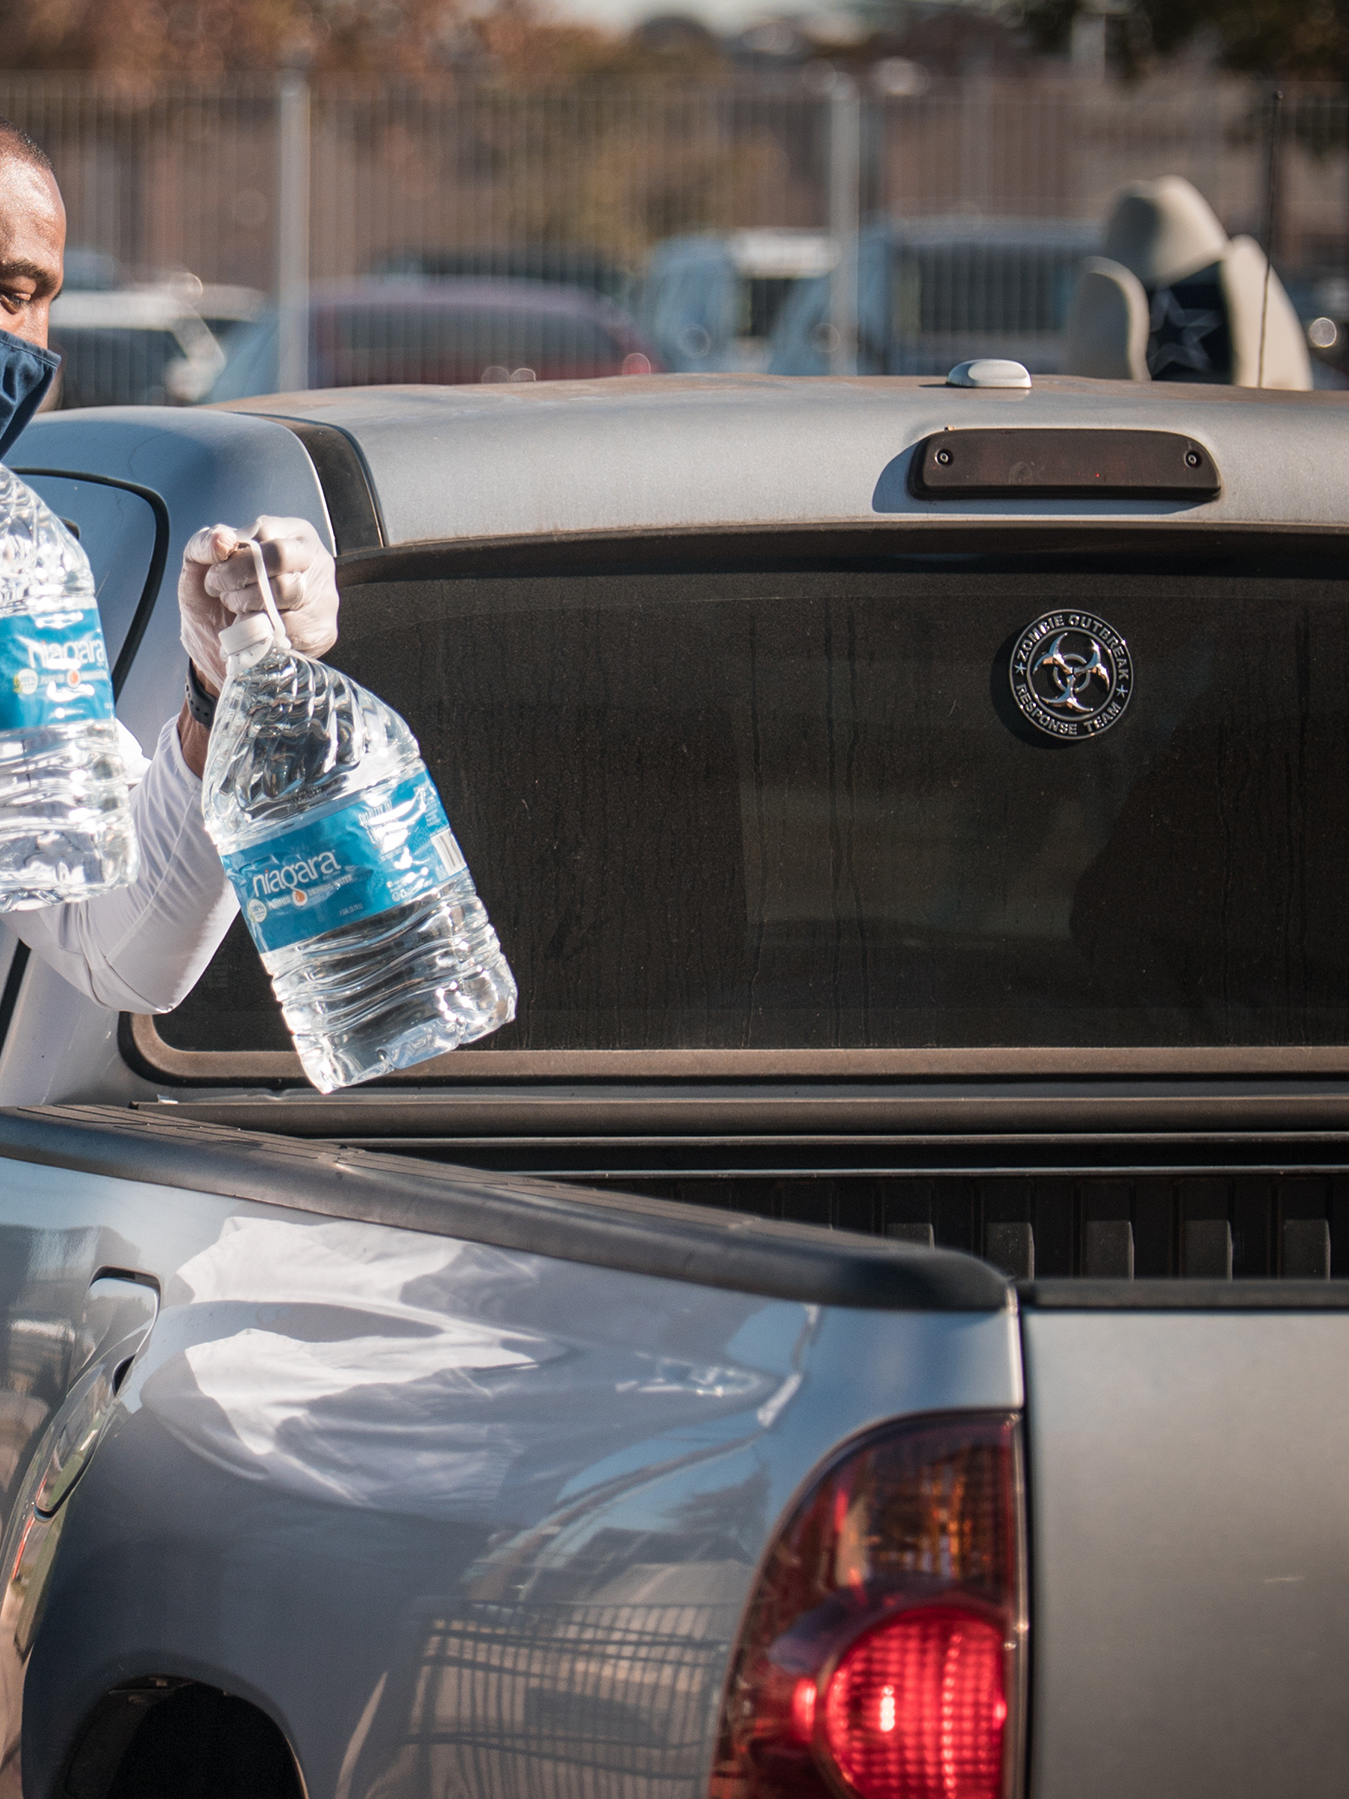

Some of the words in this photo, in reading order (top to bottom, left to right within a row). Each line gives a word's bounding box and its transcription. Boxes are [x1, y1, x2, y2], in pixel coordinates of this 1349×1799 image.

[1017, 615, 1065, 662] ZOMBIE
[1068, 614, 1129, 680] OUTBREAK
[1016, 683, 1078, 735] RESPONSE
[1083, 701, 1122, 732] TEAM
[253, 850, 342, 902] niagara
